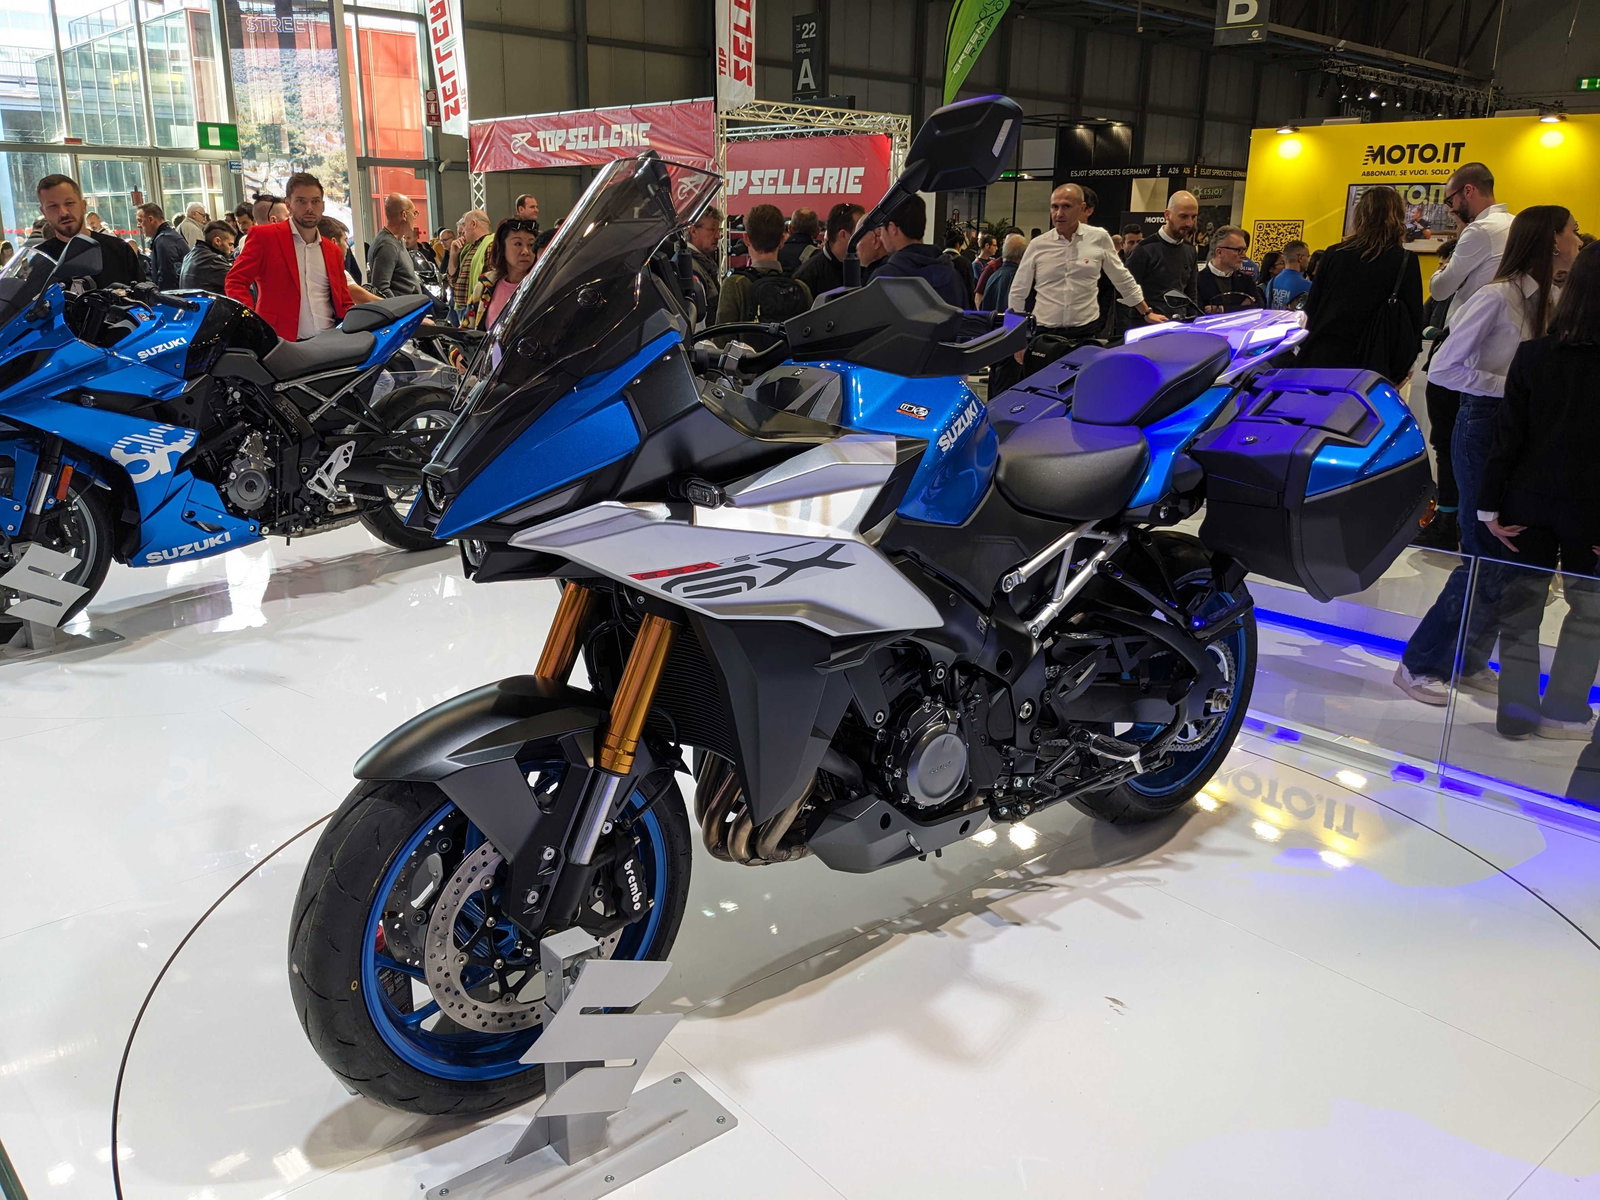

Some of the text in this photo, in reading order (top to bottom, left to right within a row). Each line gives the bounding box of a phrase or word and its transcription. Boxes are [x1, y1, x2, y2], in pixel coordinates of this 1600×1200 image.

[245, 17, 316, 33] STREET
[801, 22, 817, 39] 22
[968, 16, 994, 58] RAMP
[718, 47, 727, 75] TOP
[952, 22, 985, 74] GREEN
[796, 58, 816, 91] A
[1361, 142, 1466, 166] MOTO.IT
[726, 167, 865, 196] OPSELLERIE
[1070, 167, 1151, 177] ESJOT SPROCKETS GERMANY
[137, 336, 188, 359] SUZUKI
[937, 399, 979, 452] SUZUKI
[145, 531, 231, 564] SUZUKI
[623, 858, 643, 911] brembo
